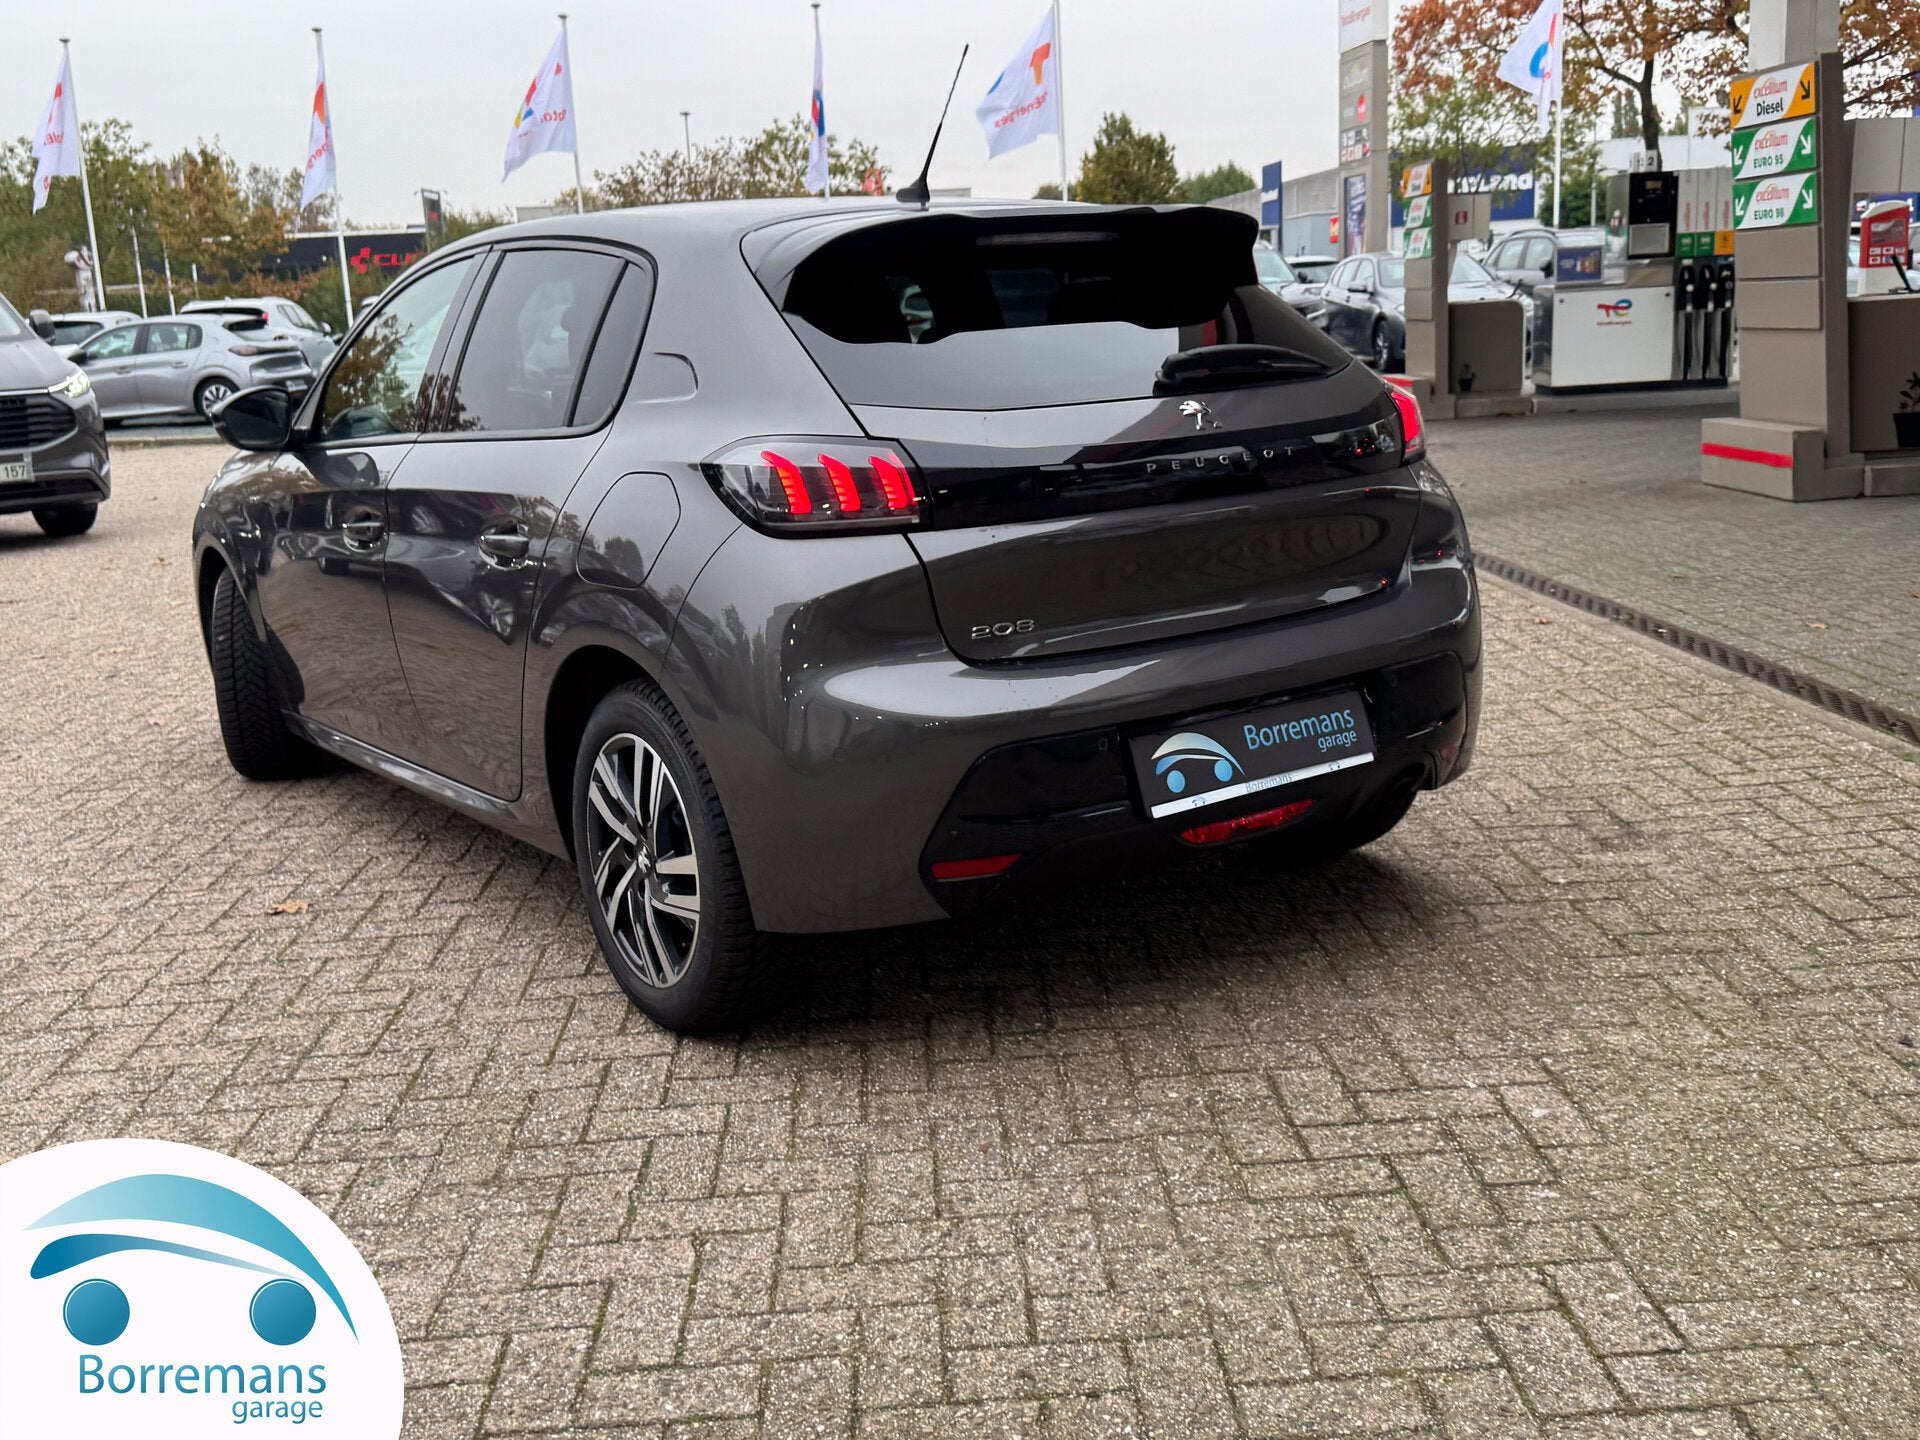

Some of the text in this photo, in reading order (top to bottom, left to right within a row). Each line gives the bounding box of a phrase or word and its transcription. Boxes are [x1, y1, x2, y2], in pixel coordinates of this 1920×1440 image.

[1756, 97, 1784, 117] Diesel
[1753, 154, 1784, 169] EURO 95
[1754, 207, 1785, 221] EURO 98
[1146, 446, 1294, 474] PEUGEOT
[4, 464, 26, 480] 157
[971, 619, 1035, 640] 208
[1243, 709, 1355, 750] Borremans
[1317, 729, 1358, 753] garage
[1245, 772, 1294, 793] Borremans
